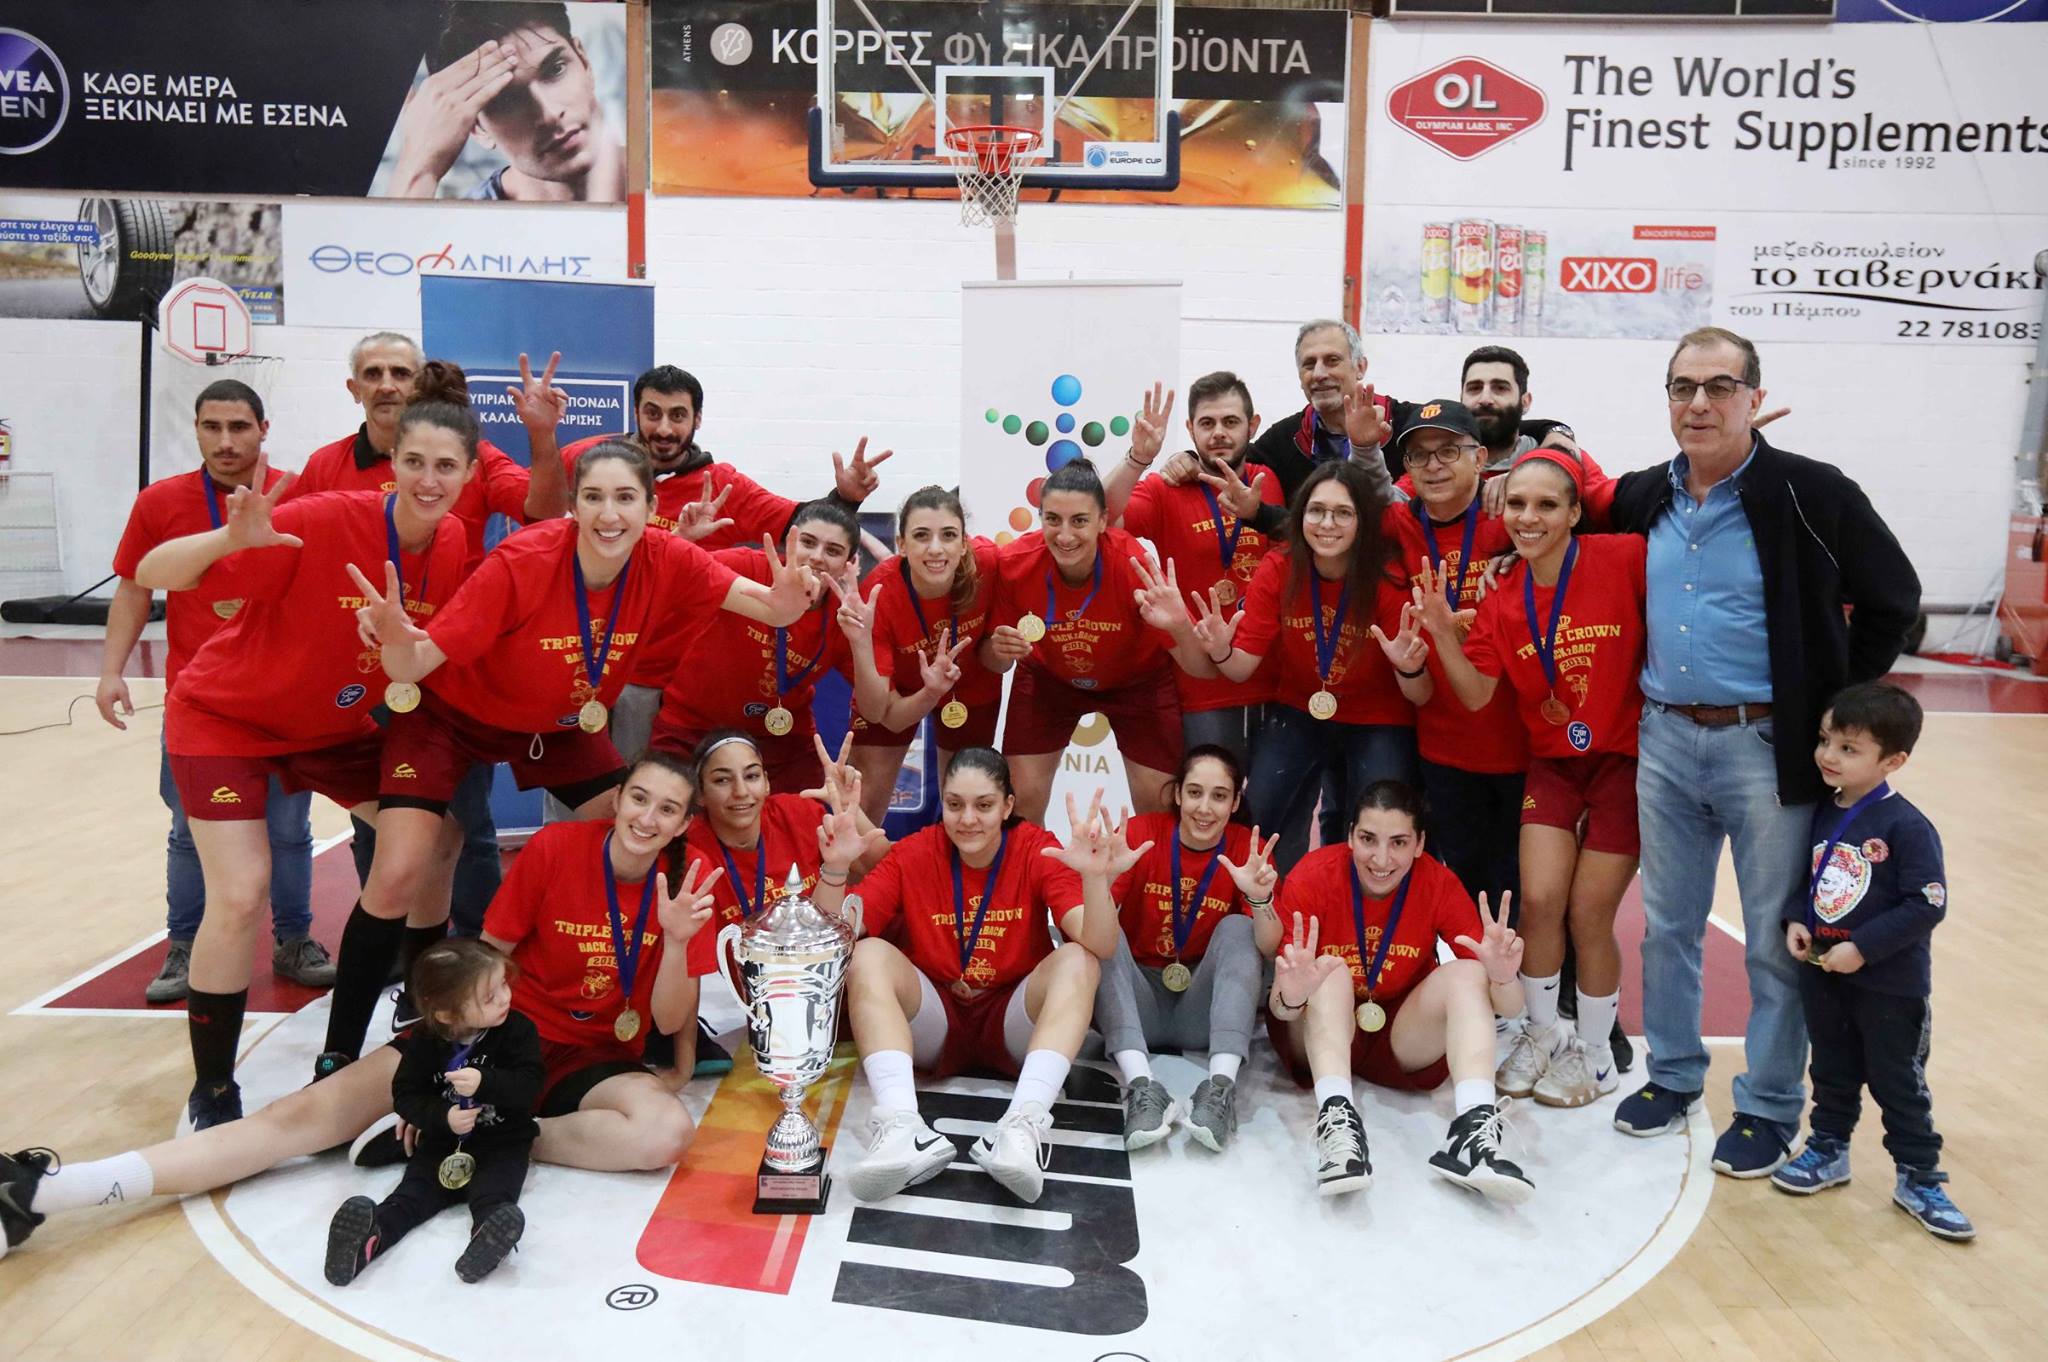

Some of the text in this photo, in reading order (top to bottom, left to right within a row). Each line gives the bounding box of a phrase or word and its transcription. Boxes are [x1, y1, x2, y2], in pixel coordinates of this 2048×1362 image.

[682, 24, 692, 62] ATHENS
[83, 72, 237, 98] ΚΑΘΕ ΜΕΡΑ
[1564, 55, 1857, 99] The World's
[1434, 72, 1497, 110] OL
[84, 98, 348, 128] ΞΕΚΙΝΑΕΙ ΜΕ ΕΣΕΝΑ
[1415, 121, 1465, 130] OLYMPIAN
[1563, 108, 1710, 172] Finest
[1843, 156, 1936, 170] since 1992
[130, 250, 173, 262] Goodyear
[1568, 260, 1651, 291] XIXO
[1663, 266, 1704, 290] life
[1751, 266, 1797, 288] το
[1728, 304, 1763, 317] του
[1897, 320, 1931, 338] 22
[1566, 624, 1622, 642] CROWN
[1561, 657, 1589, 670] 2019
[554, 920, 612, 939] TRIPLE
